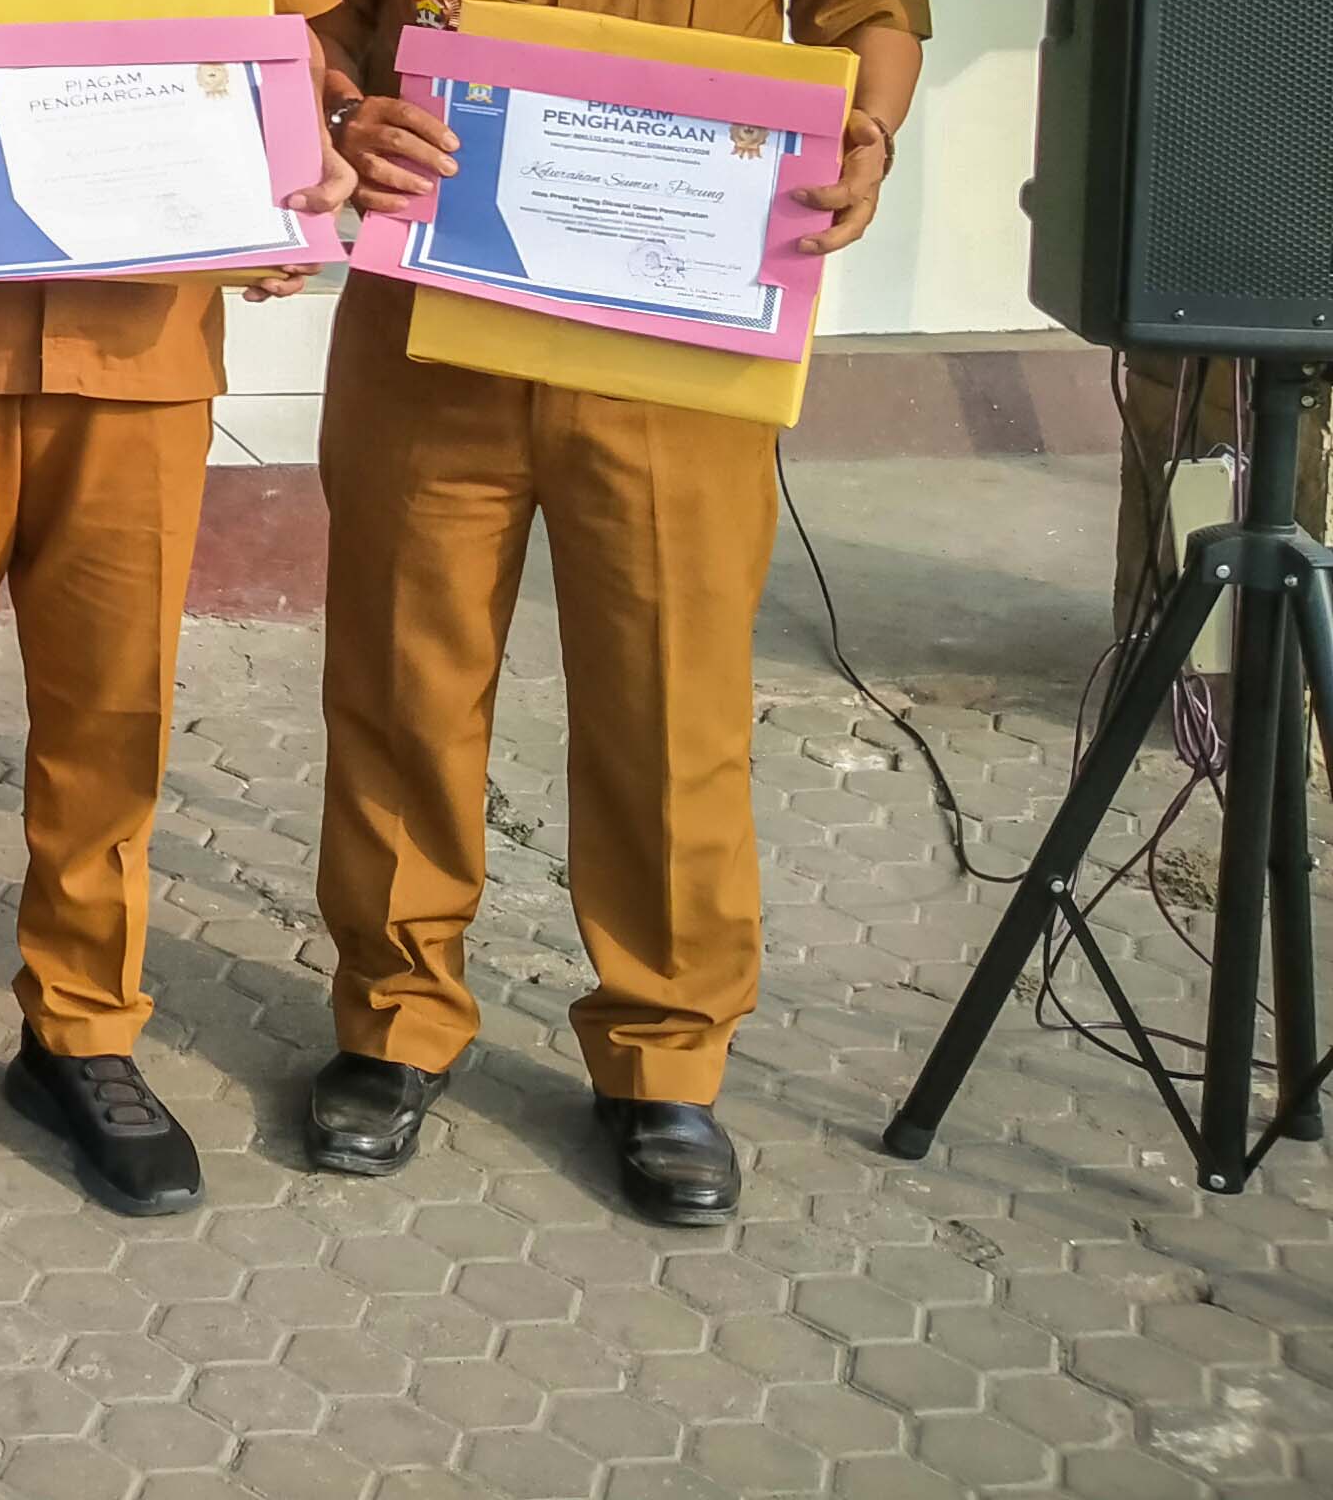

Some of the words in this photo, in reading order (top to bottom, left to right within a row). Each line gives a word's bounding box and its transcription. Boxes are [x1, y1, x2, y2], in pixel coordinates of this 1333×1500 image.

[64, 72, 143, 93] PIAGAM
[28, 83, 186, 113] PENGHARGAAN
[586, 100, 674, 122] PIAGAM
[542, 109, 716, 143] PENGHARGAAN
